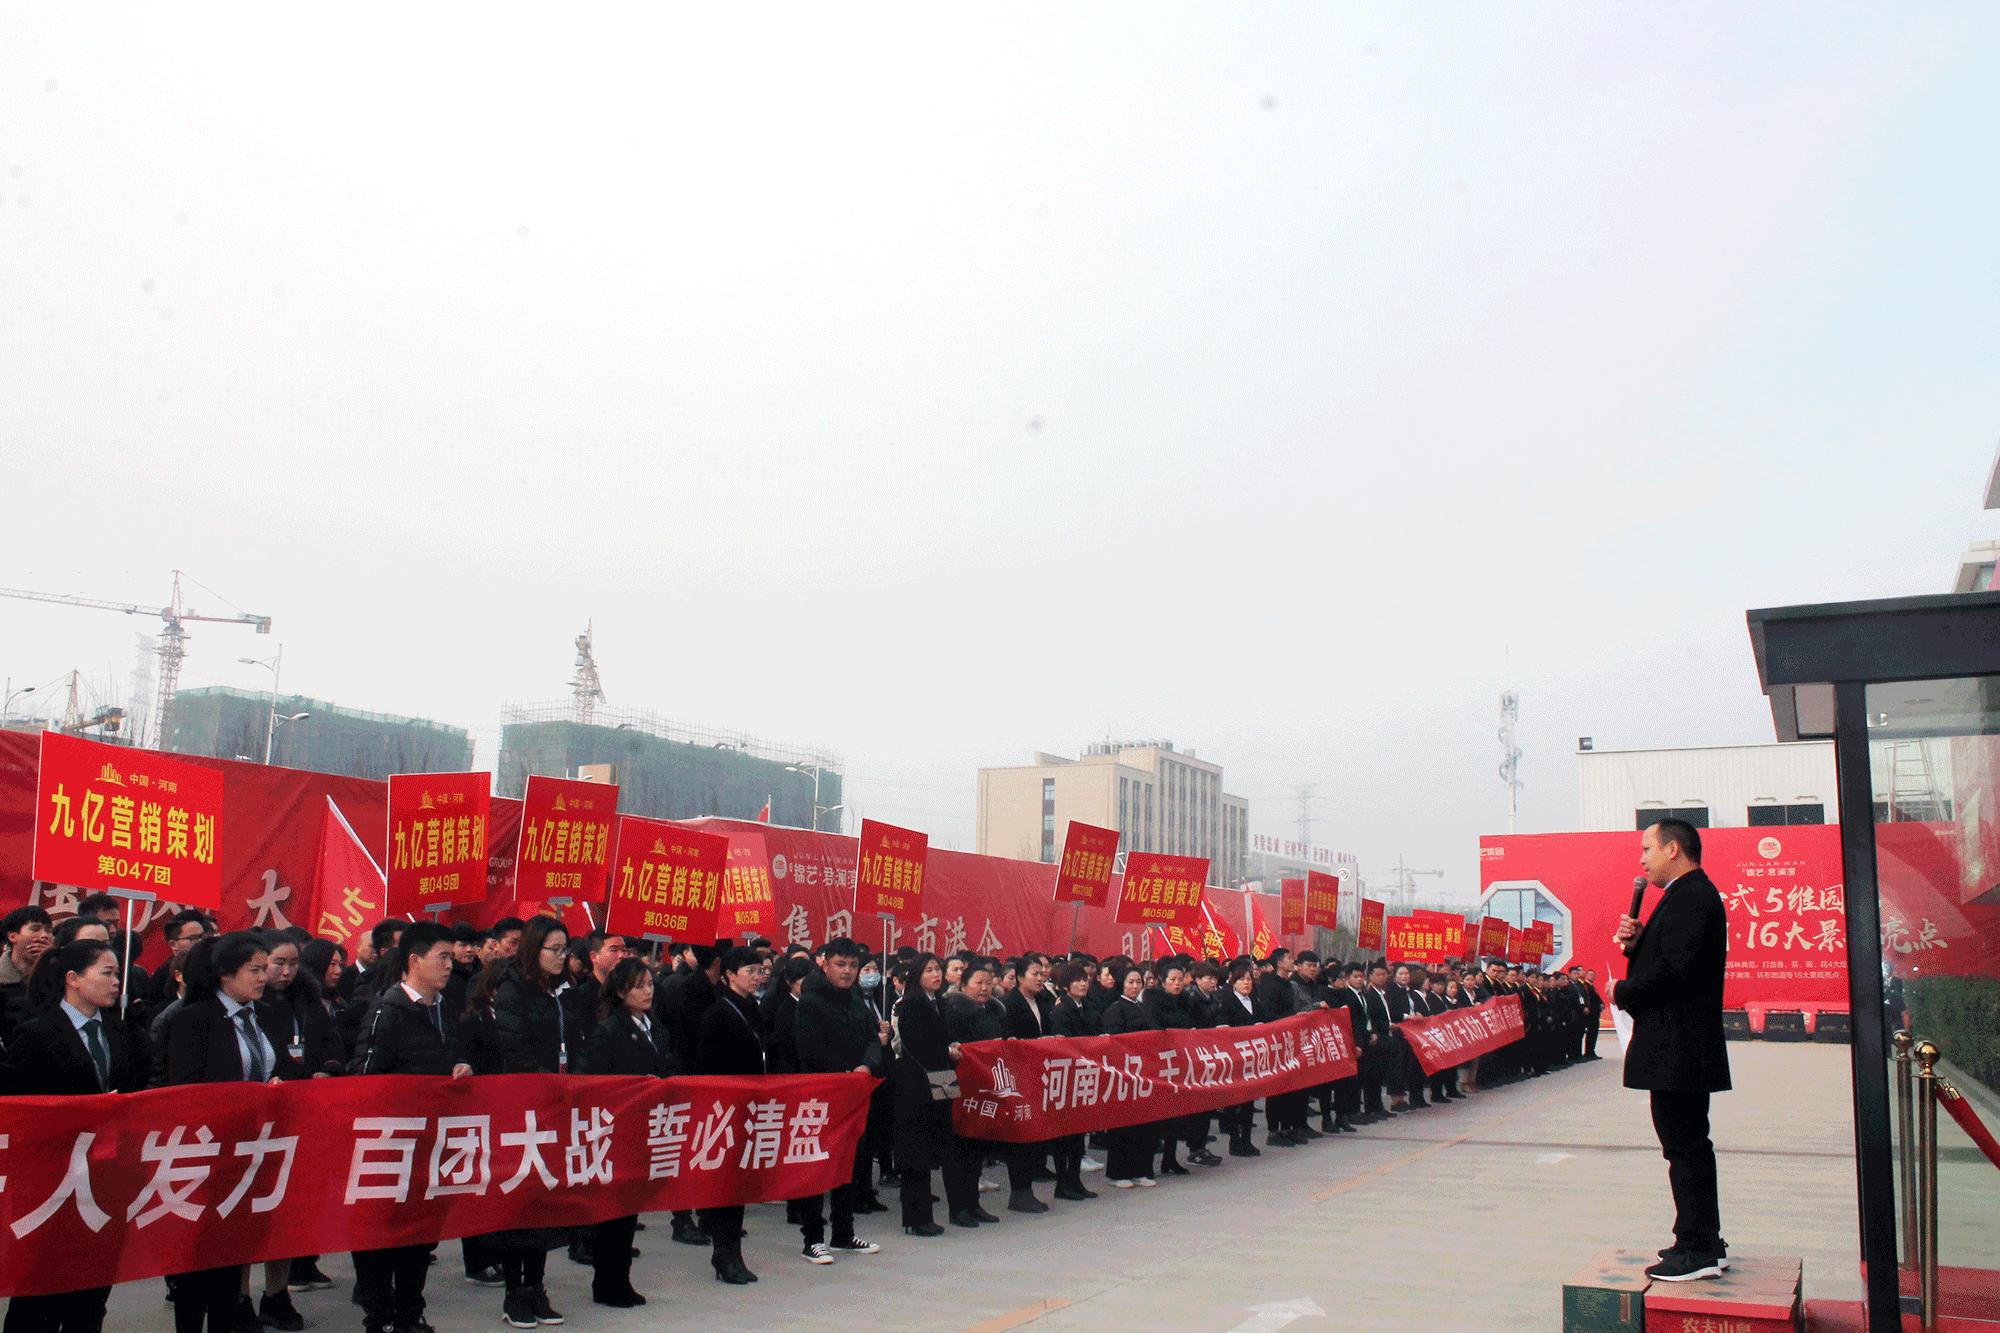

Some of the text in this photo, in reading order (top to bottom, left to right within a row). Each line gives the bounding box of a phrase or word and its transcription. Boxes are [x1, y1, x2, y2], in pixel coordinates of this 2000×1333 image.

[49, 783, 216, 865] 九亿营销策划
[524, 816, 610, 866] 九亿营销策划
[394, 814, 485, 871] 九亿营销策划
[97, 854, 172, 886] 第047团
[419, 873, 460, 895] 第049团
[545, 871, 582, 889] 第057团
[861, 849, 923, 895] 九亿营销策划
[1063, 848, 1111, 884] 九亿营销策划
[619, 857, 720, 912] 九亿营销策划
[721, 866, 772, 904] 亿营销策划
[1125, 876, 1201, 907] 九亿营销策划
[1720, 884, 1845, 917] 式5维园
[644, 911, 689, 931] 第036团
[1389, 931, 1443, 950] 九亿营销策划
[1041, 1052, 1153, 1111] 河南九亿
[1158, 1045, 1234, 1094] 千人发力
[1234, 1031, 1301, 1081] 百团大战
[962, 1095, 1033, 1122] 中国·河南
[0, 1097, 831, 1240] 人发力 百团大战 誓必清盘
